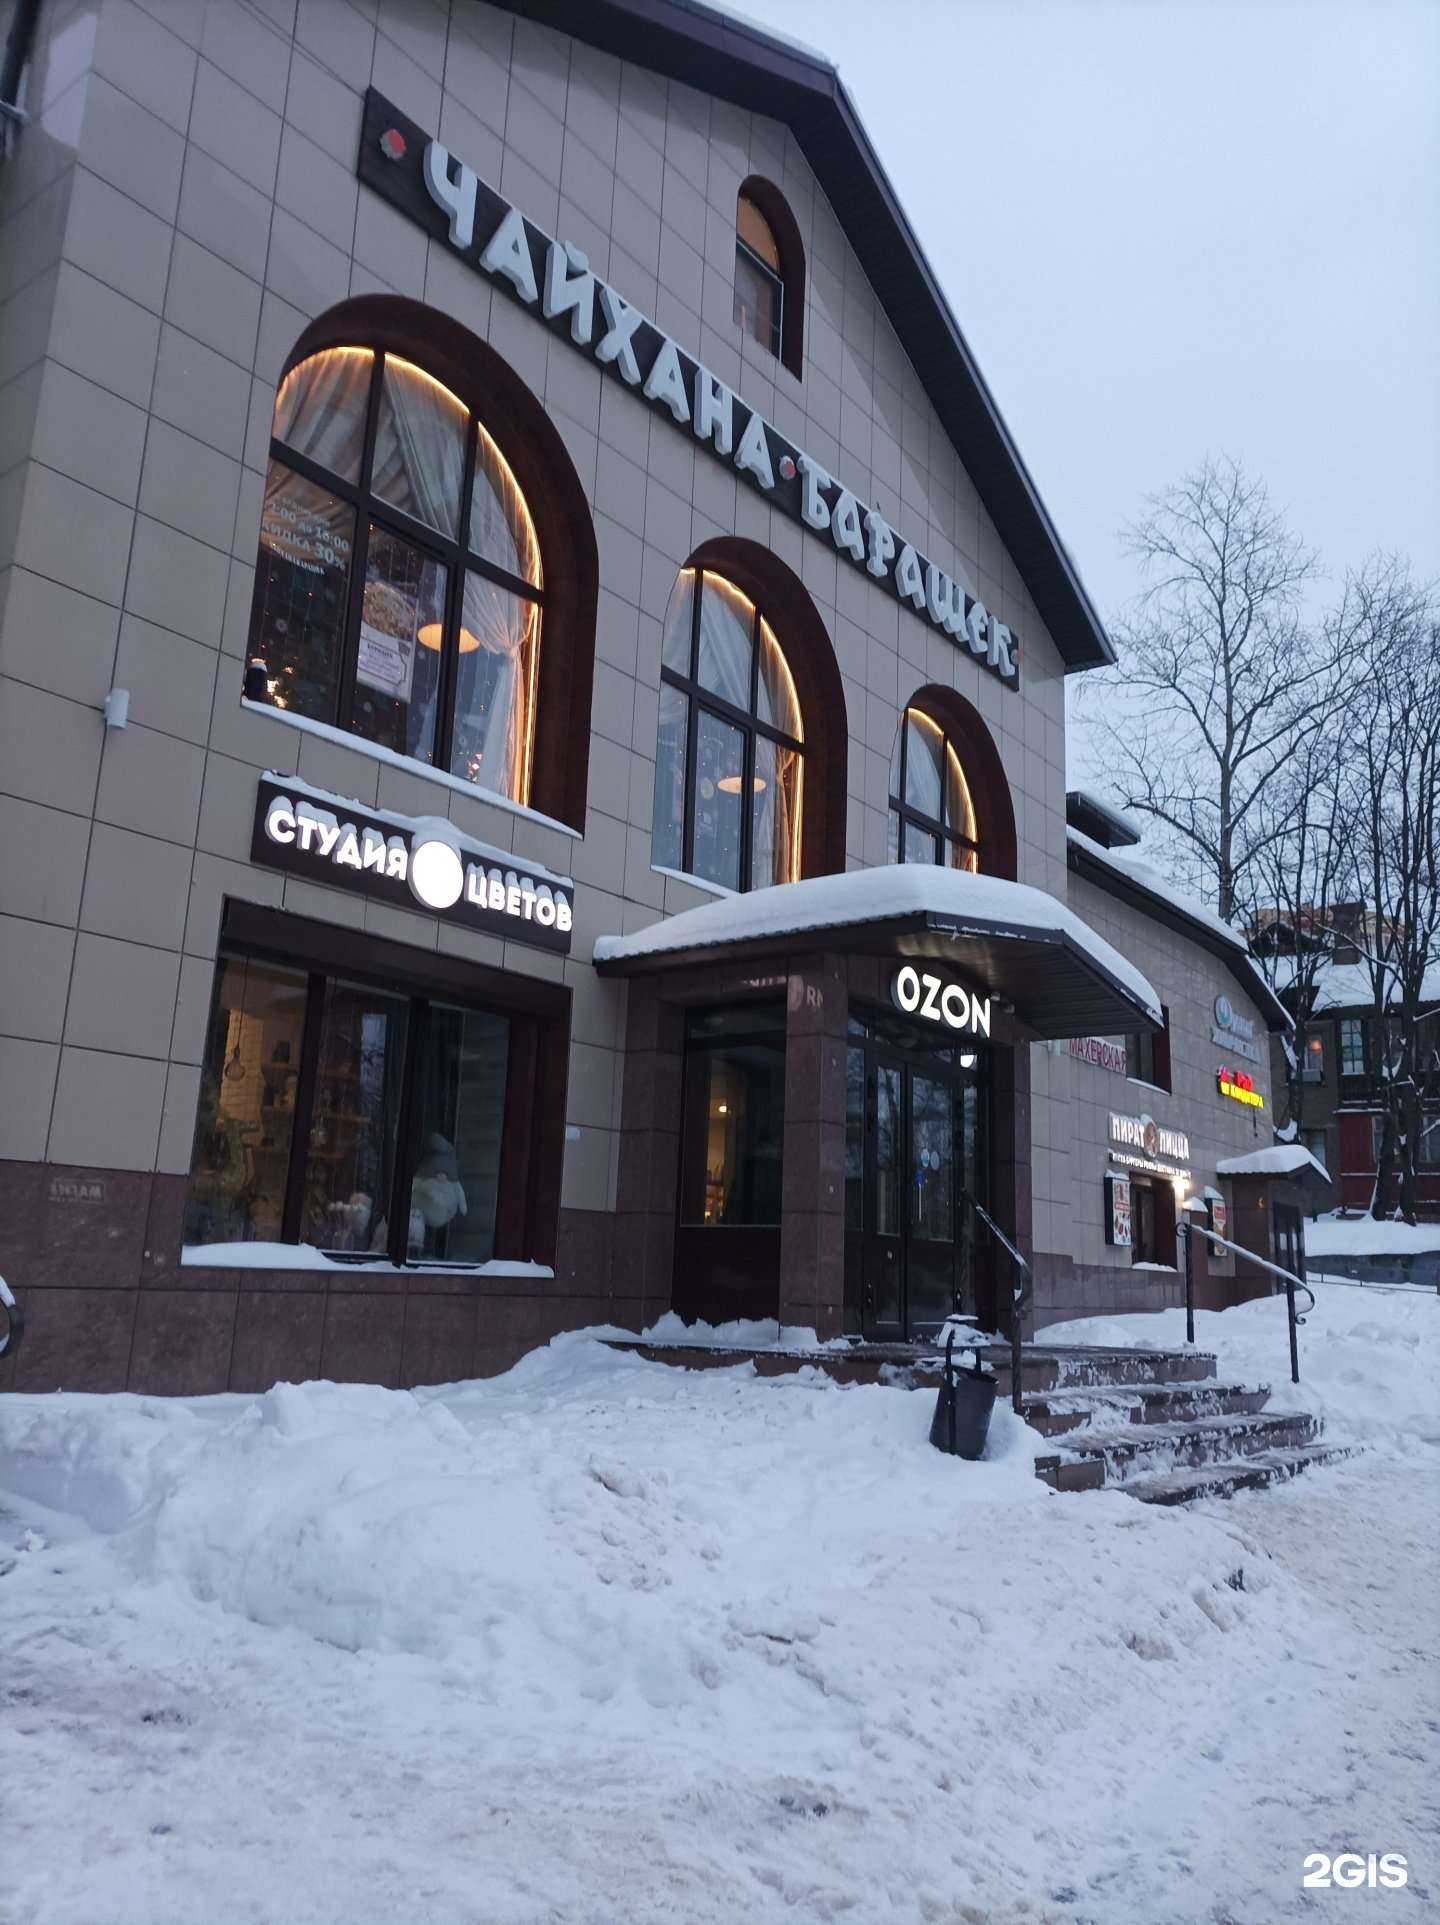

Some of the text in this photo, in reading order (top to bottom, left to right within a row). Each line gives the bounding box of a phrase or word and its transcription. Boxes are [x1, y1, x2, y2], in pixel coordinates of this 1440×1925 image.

[423, 140, 776, 490] ЧАЙХАНА
[266, 809, 573, 932] СТУДИЯ ЦВЕТОВ
[894, 965, 991, 1038] OZON
[1112, 1117, 1190, 1161] ПИРАТ ПИЦЦА
